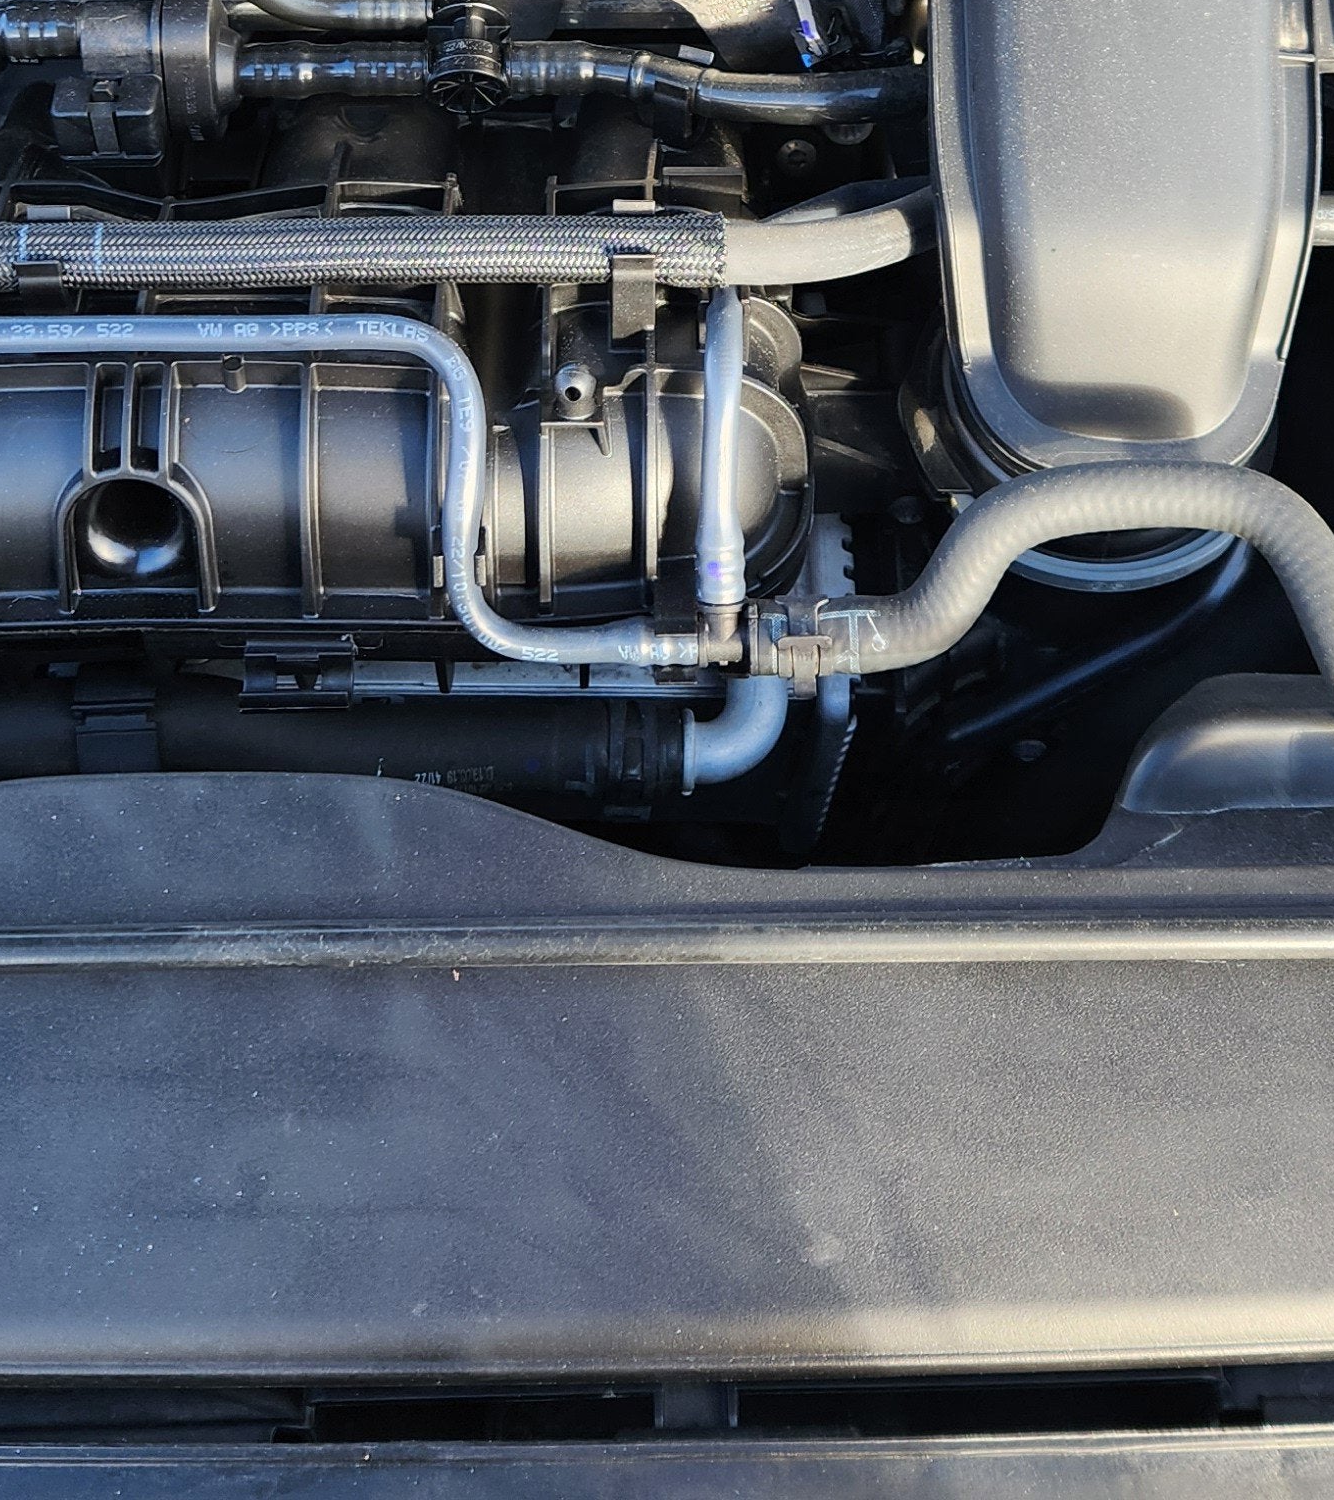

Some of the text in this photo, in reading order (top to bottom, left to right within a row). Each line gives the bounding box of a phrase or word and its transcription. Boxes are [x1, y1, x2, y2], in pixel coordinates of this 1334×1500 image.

[97, 323, 135, 339] 522
[197, 323, 223, 339] VW
[233, 322, 260, 338] AG
[270, 321, 334, 338] >PPS<
[356, 319, 431, 344] TEKLAS
[520, 645, 560, 663] 522
